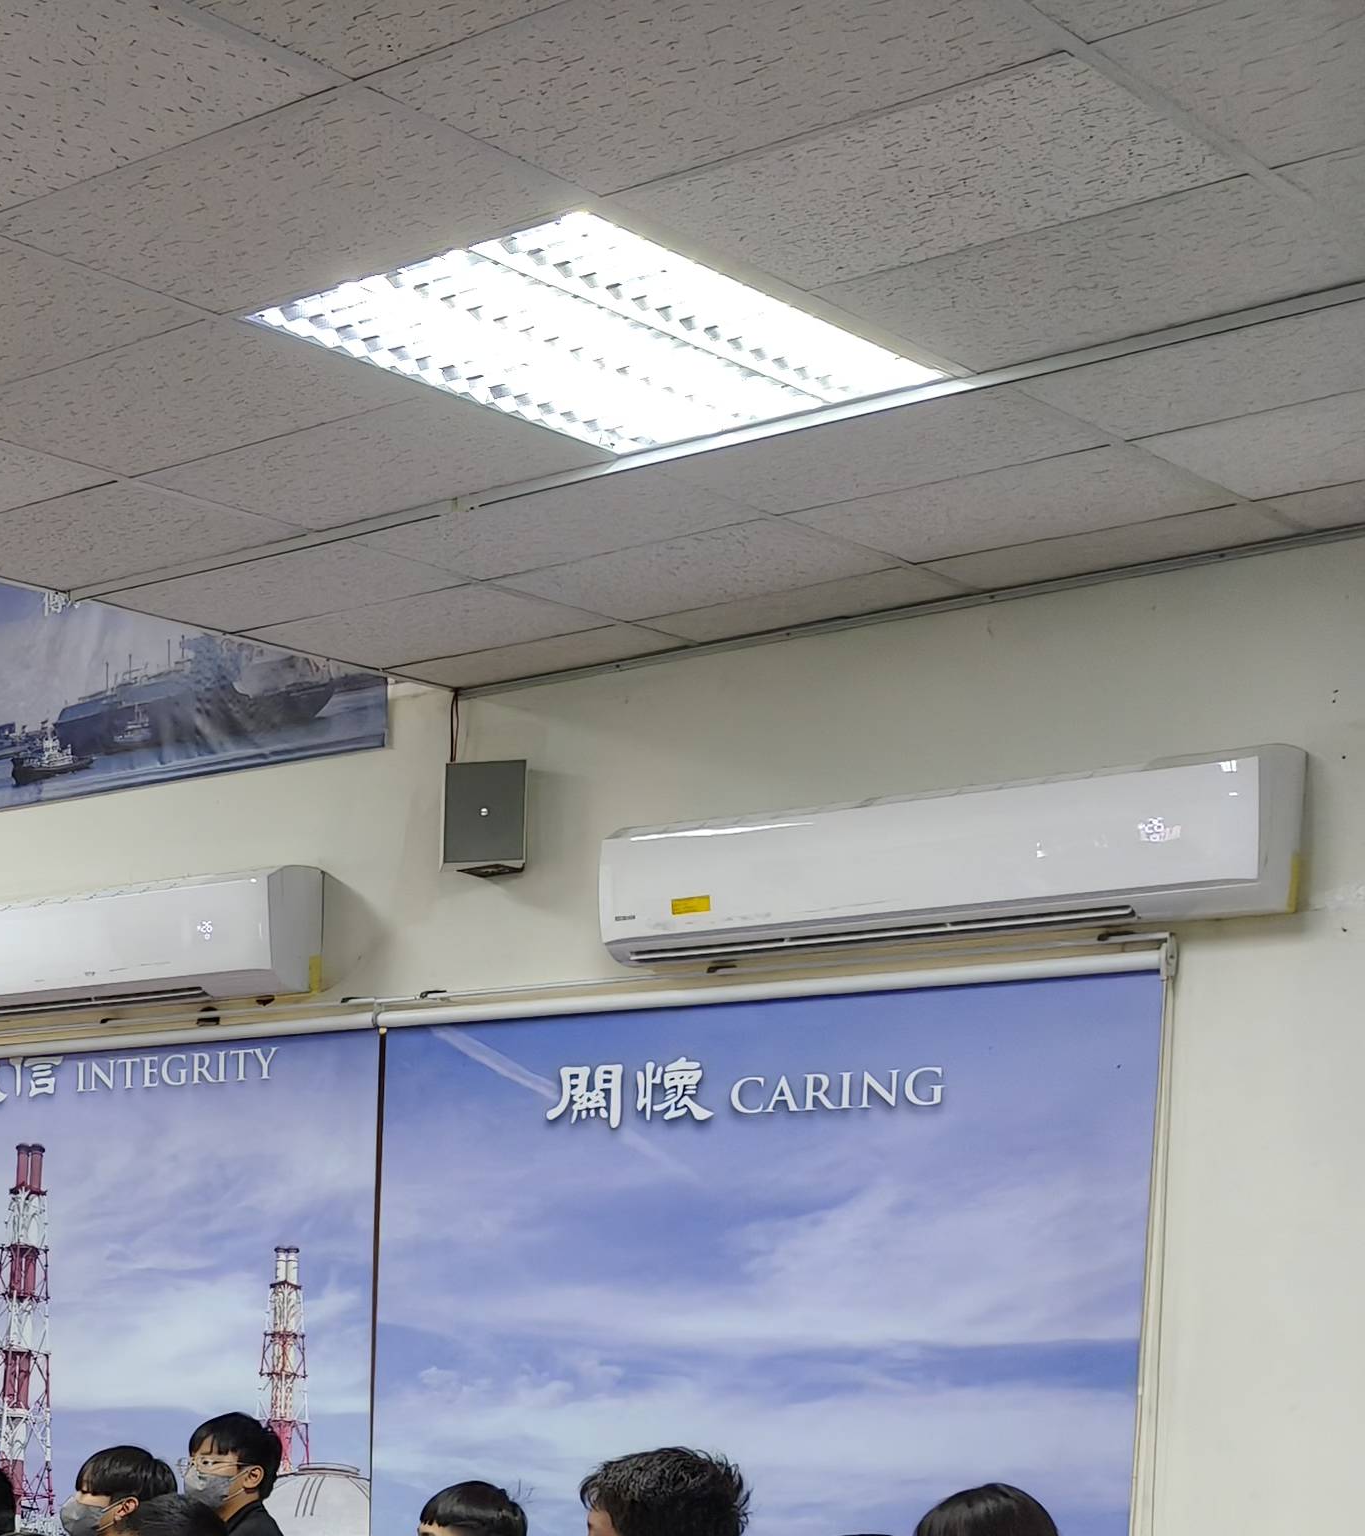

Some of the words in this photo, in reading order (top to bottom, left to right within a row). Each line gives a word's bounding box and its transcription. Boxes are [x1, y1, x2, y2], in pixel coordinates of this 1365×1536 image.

[76, 1046, 280, 1092] INTEGRITY
[546, 1056, 715, 1128] 關懷
[730, 1066, 946, 1114] CARING
